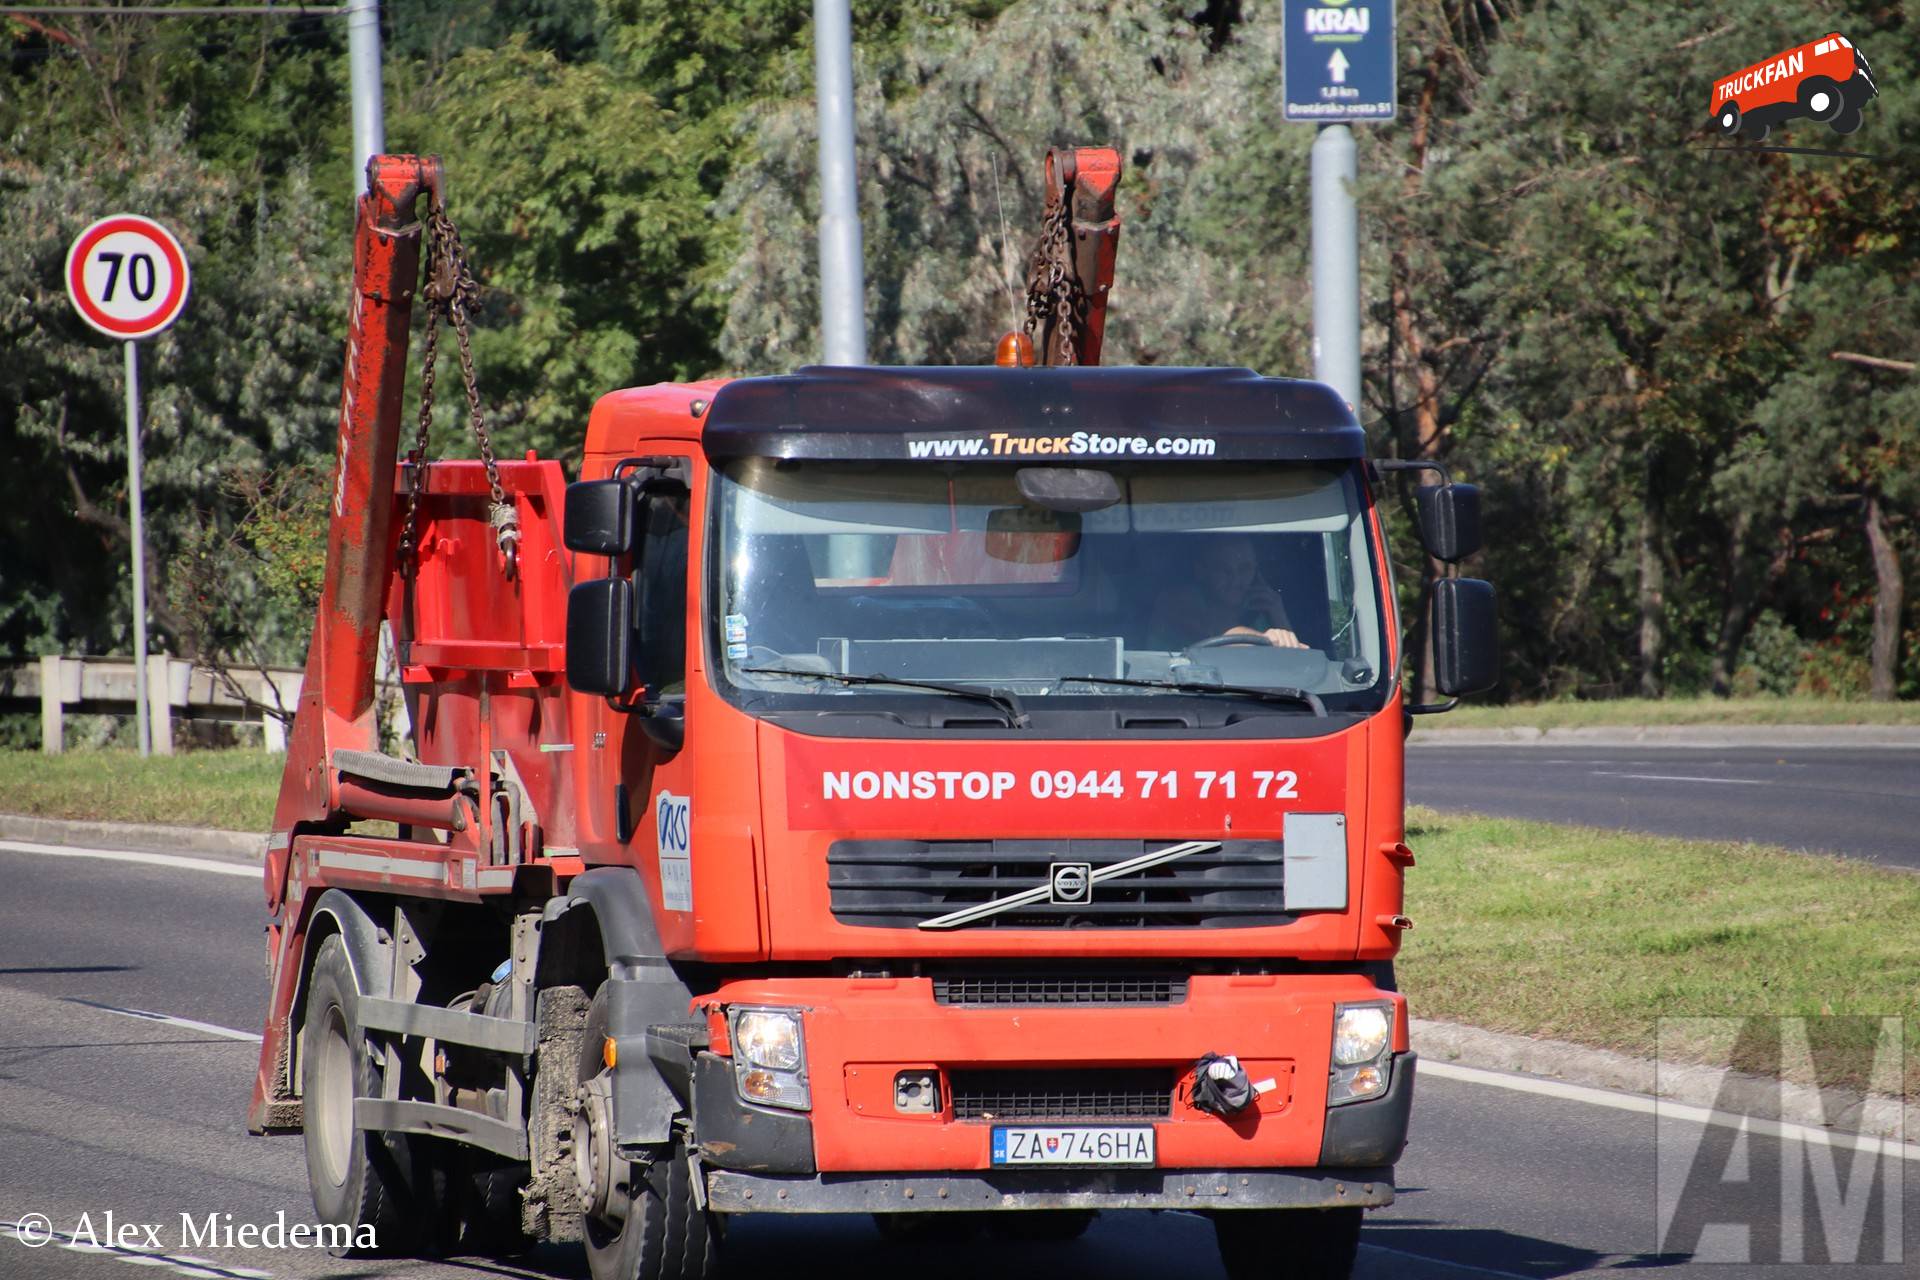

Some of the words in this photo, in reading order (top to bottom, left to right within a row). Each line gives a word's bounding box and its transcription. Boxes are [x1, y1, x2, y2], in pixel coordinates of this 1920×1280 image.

[1340, 86, 1359, 97] km
[98, 252, 155, 302] 70
[908, 432, 1216, 458] www.TruckStore.com
[823, 770, 1016, 800] NONSTOP
[1030, 770, 1124, 799] 0944
[1136, 770, 1178, 798] 71
[1194, 770, 1236, 798] 71
[1252, 770, 1299, 798] 72
[1011, 1133, 1044, 1159] ZA
[1061, 1133, 1149, 1159] 746HA
